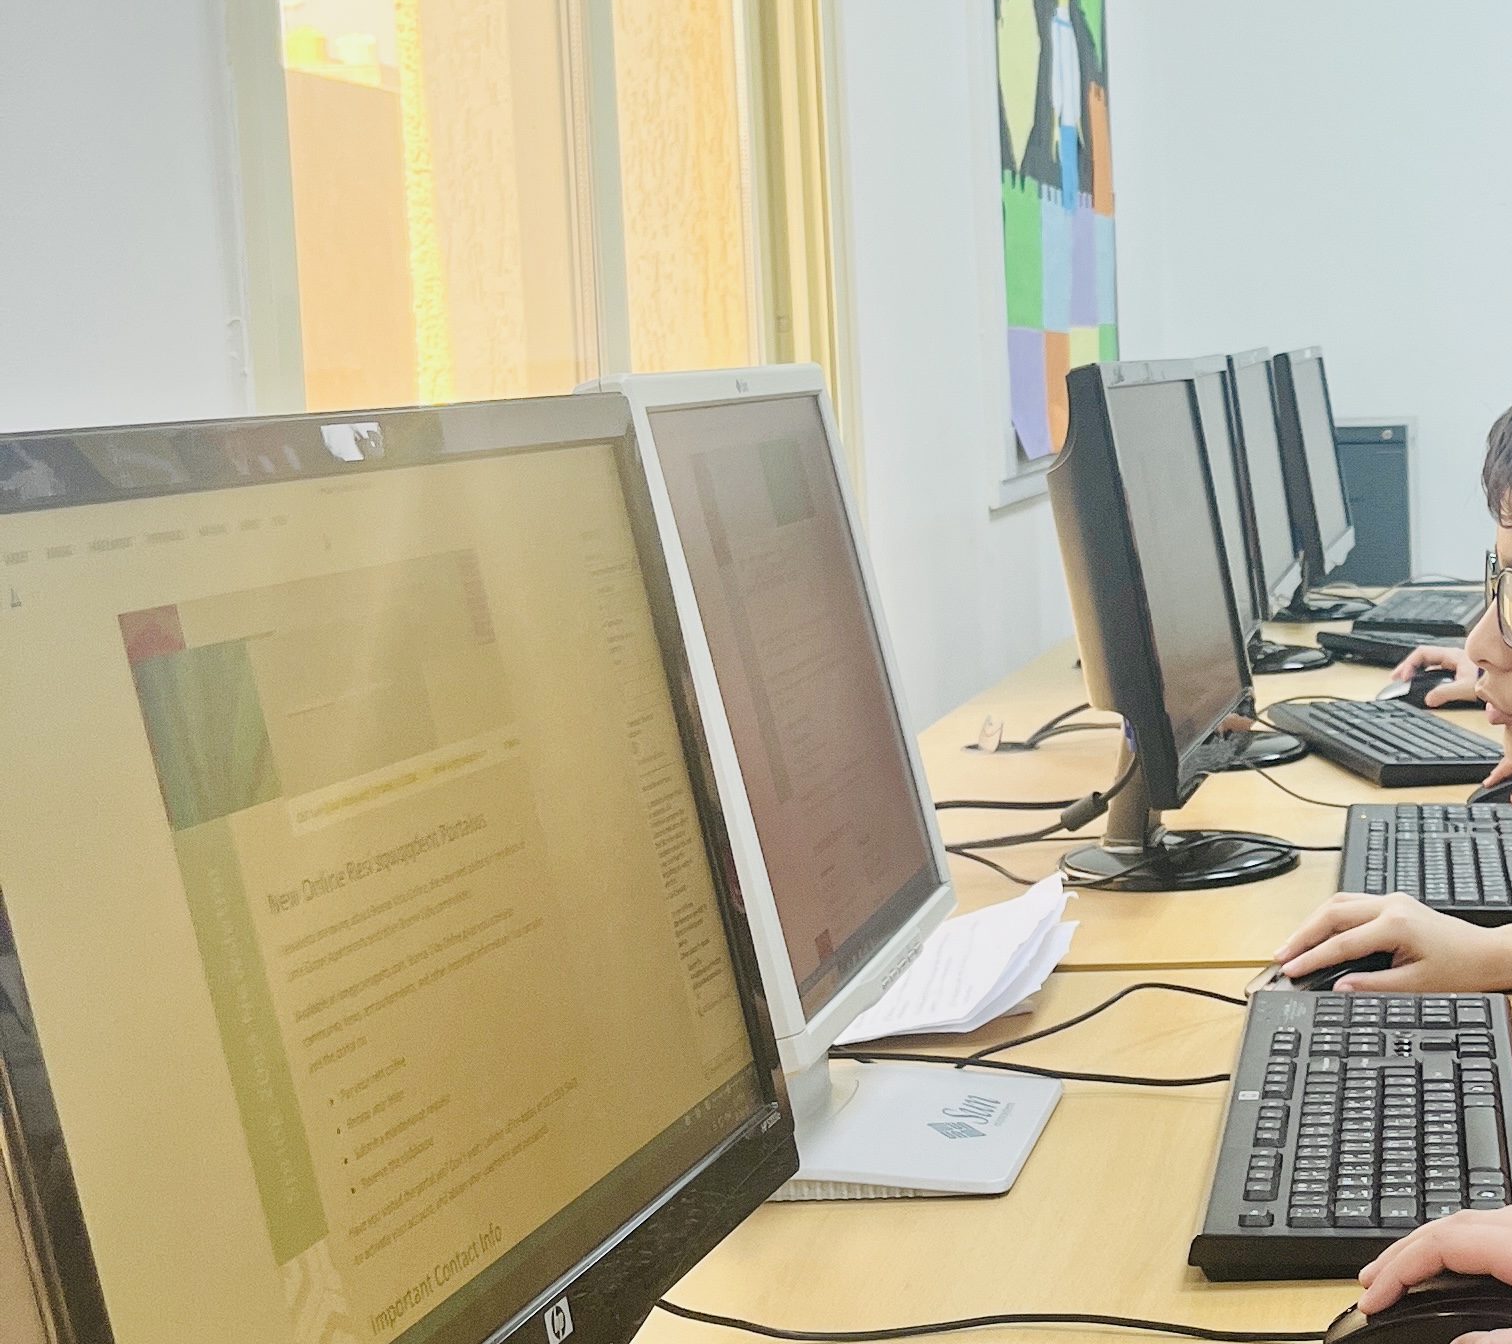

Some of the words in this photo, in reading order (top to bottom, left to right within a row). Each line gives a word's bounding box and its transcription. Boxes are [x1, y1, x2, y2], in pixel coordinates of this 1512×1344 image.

[942, 1094, 1002, 1125] Sun
[371, 1276, 434, 1337] Important
[434, 1242, 481, 1289] Contact
[479, 1221, 503, 1255] Info
